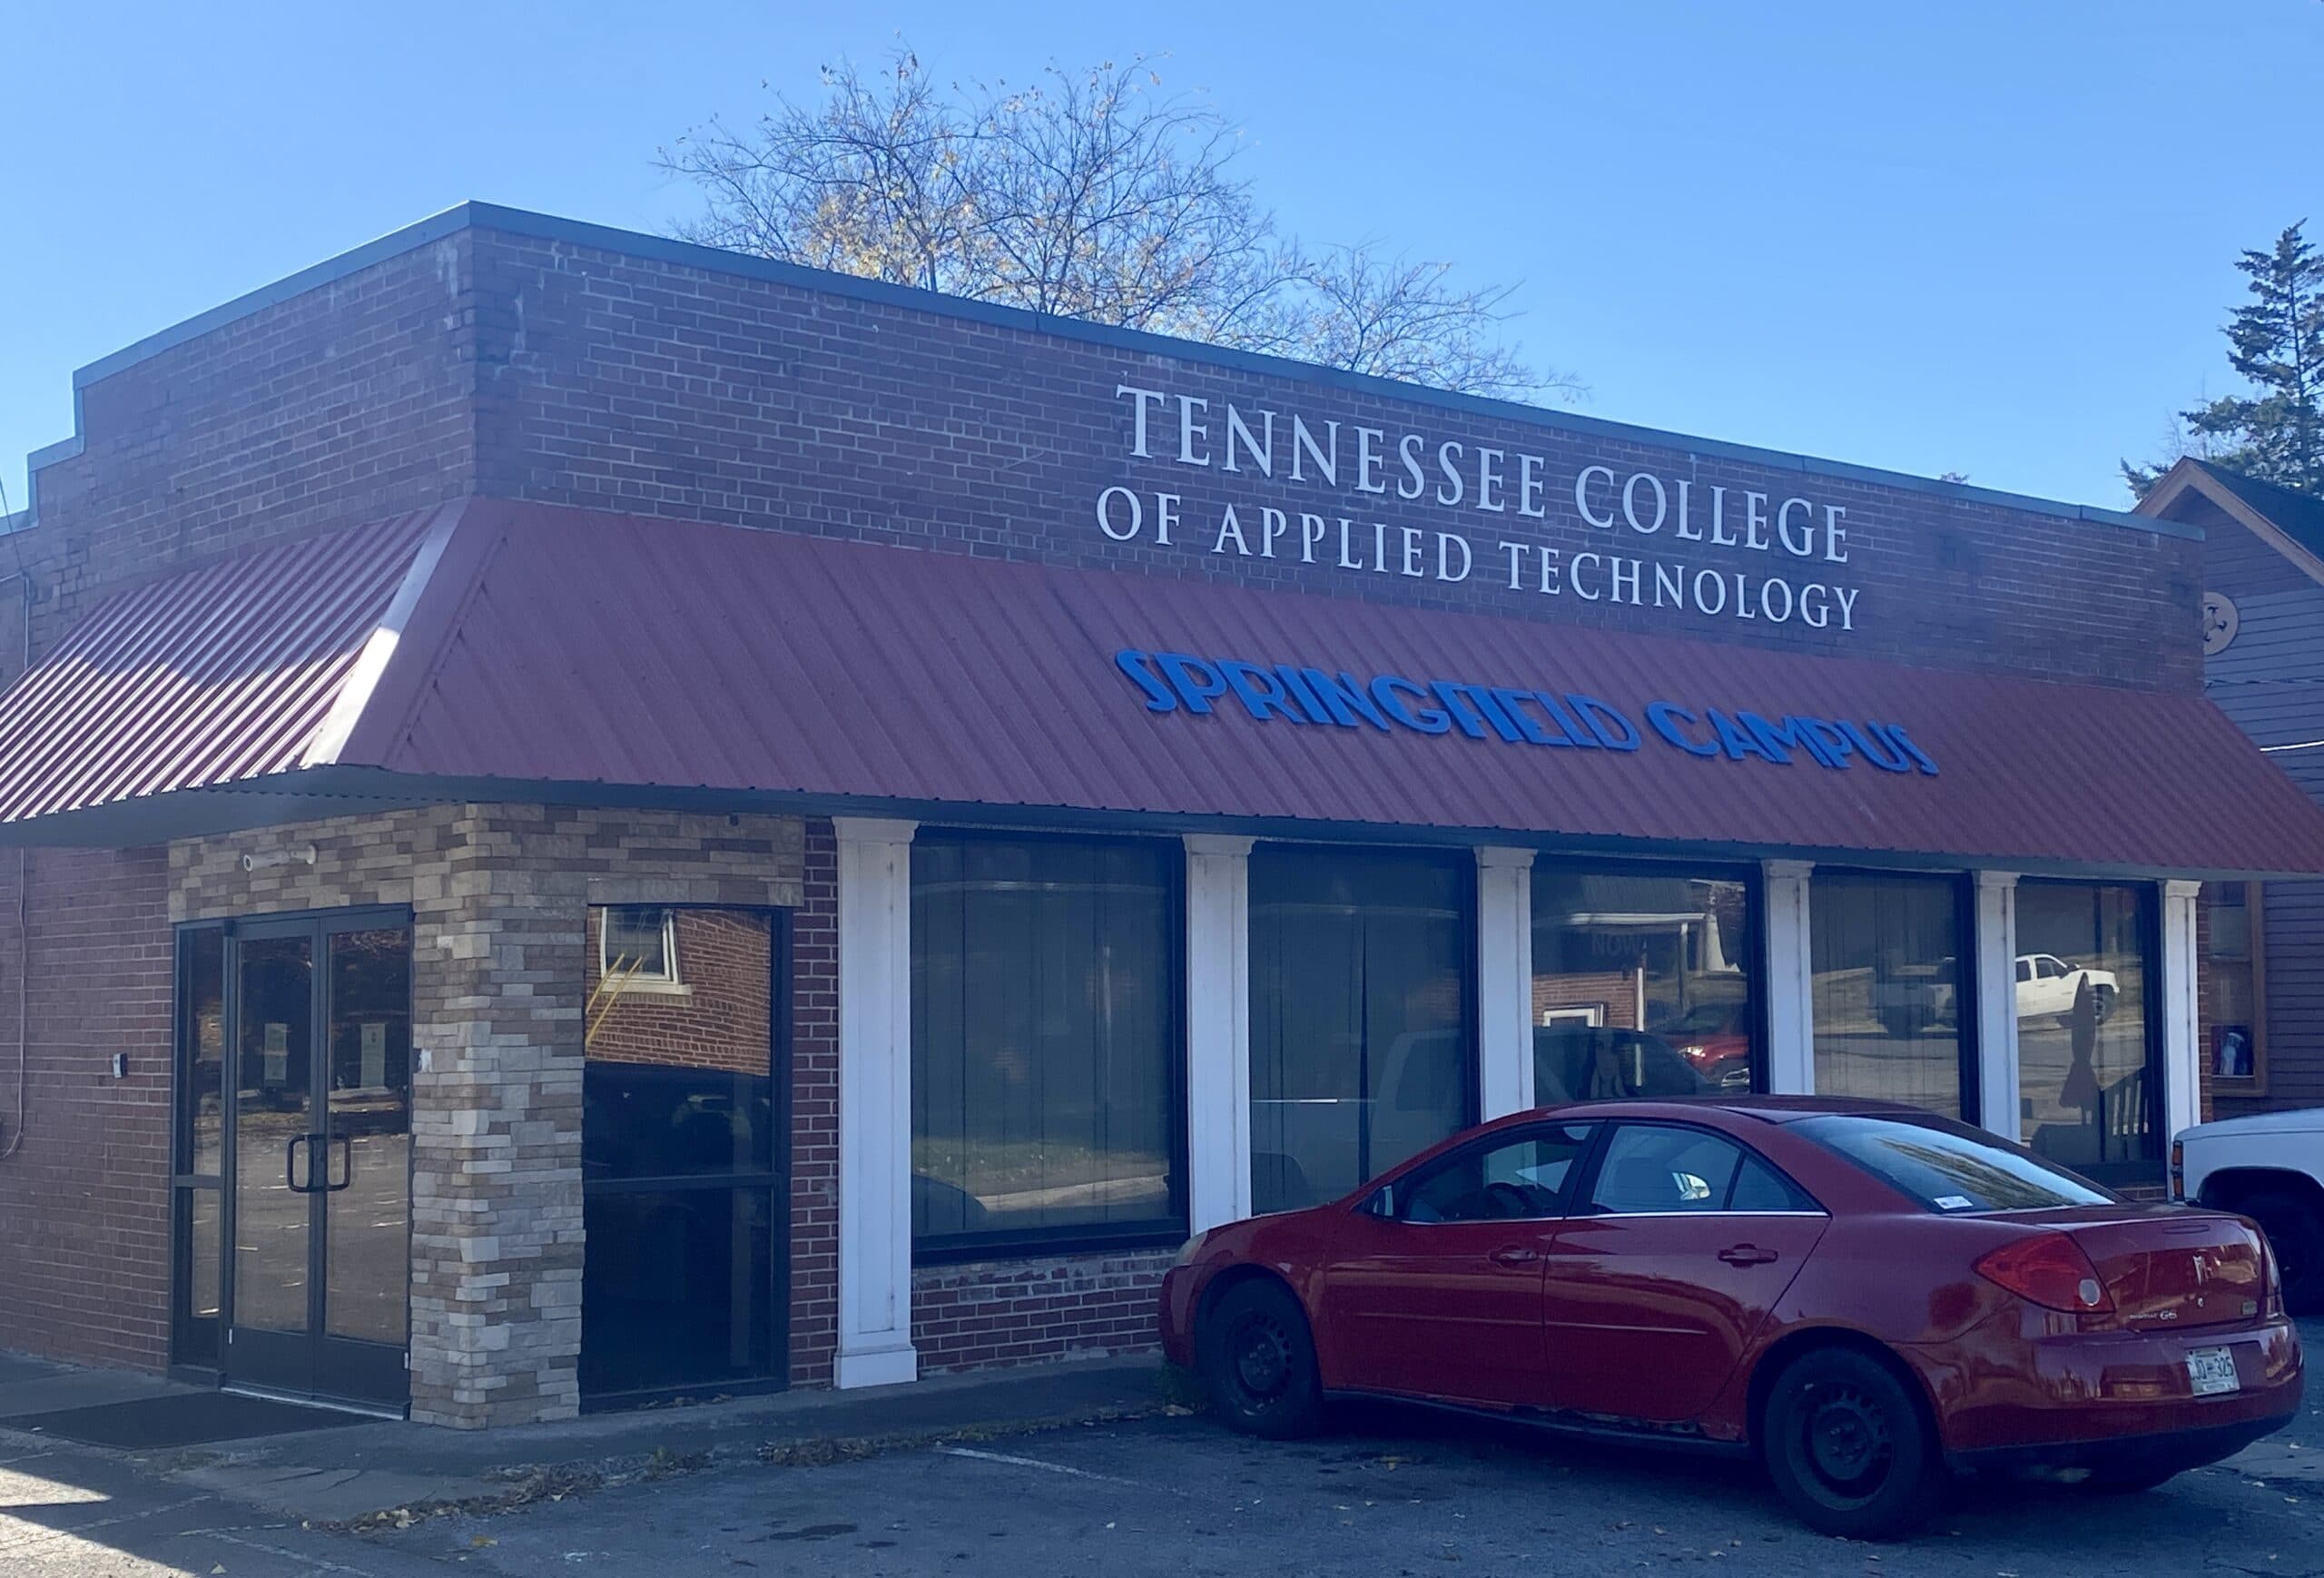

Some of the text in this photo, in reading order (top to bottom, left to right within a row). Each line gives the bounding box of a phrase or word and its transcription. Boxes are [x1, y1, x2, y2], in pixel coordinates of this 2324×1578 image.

[1116, 384, 1849, 564] TENNESSEE COLLEGE
[1097, 486, 1859, 630] OF APPLIED TECHNOLOGY
[1115, 648, 1940, 775] SPRINGFIELD CAMPUS
[2160, 1311, 2177, 1320] G6
